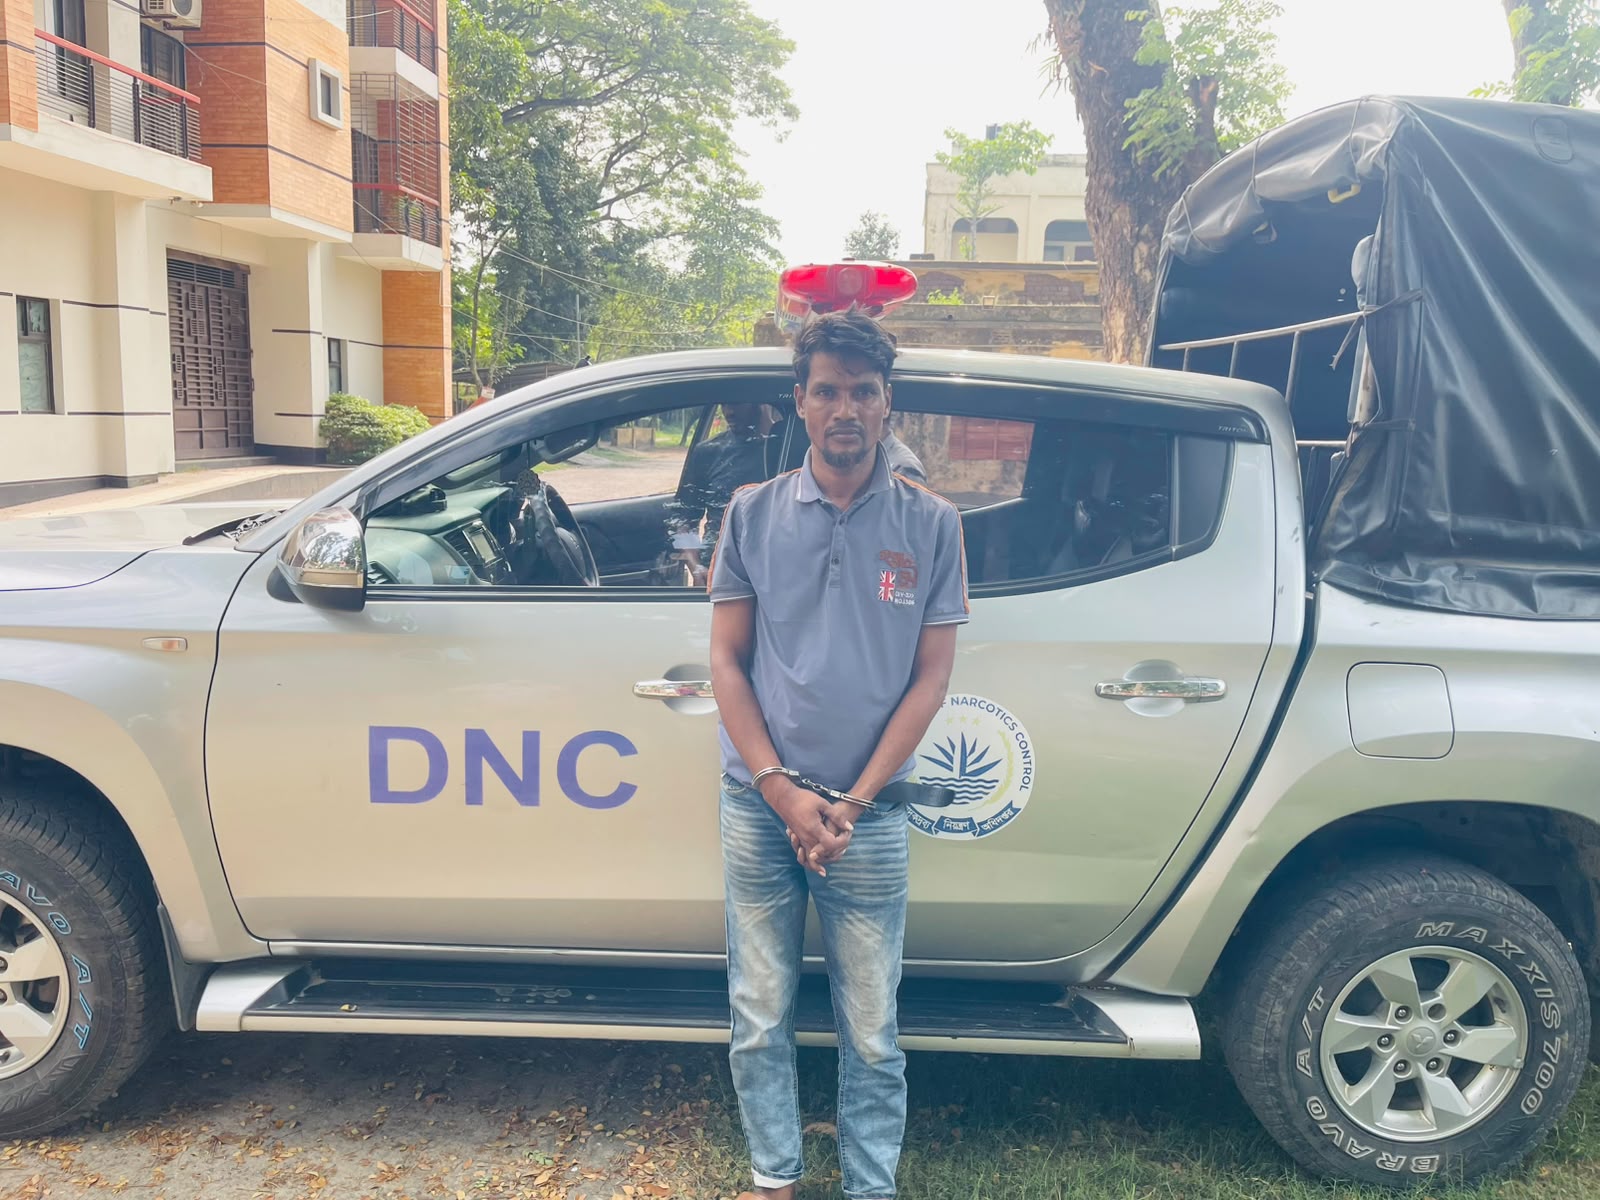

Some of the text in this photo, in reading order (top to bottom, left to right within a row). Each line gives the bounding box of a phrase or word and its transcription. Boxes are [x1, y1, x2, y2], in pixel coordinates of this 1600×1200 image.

[368, 725, 639, 810] DNC
[950, 695, 1033, 792] NARCOTICS CONTROL
[71, 953, 94, 1050] A/T
[1415, 921, 1561, 1115] MAXXIS 700
[1296, 985, 1440, 1173] BRAVO A/T
